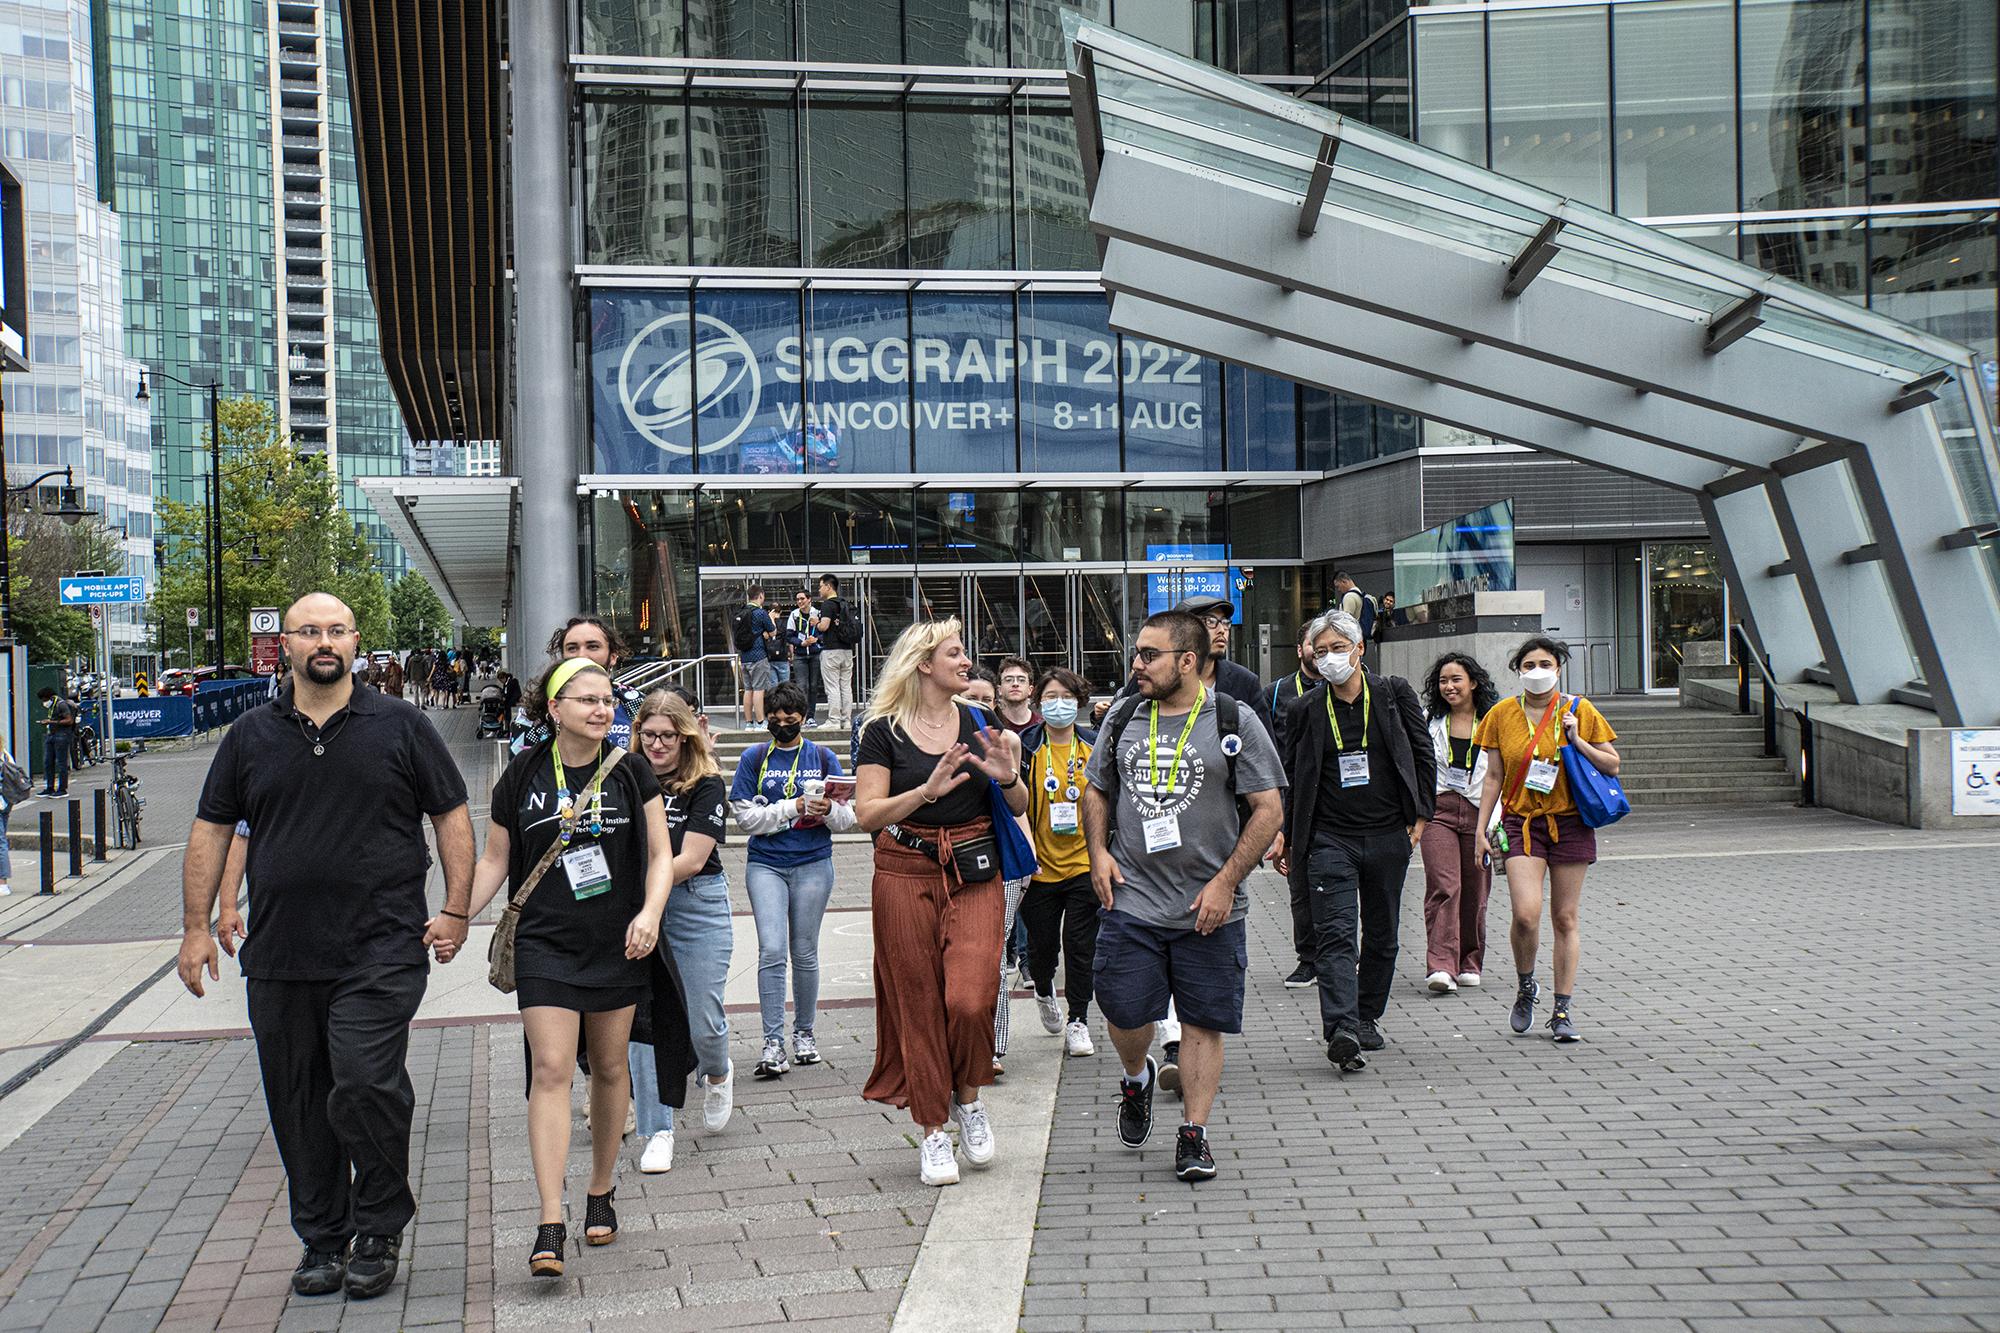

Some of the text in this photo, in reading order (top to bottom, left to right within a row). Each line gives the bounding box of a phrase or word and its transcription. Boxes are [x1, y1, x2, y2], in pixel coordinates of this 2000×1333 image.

[775, 337, 1202, 384] SIGGRAPH 2022
[777, 401, 1202, 430] VANCOUVER+ 8-11 AUG
[260, 616, 270, 628] P
[110, 710, 162, 720] ANCOUVER
[611, 724, 630, 733] 022
[1142, 734, 1169, 747] NNE
[1183, 741, 1197, 757] HE
[802, 769, 821, 777] 2022
